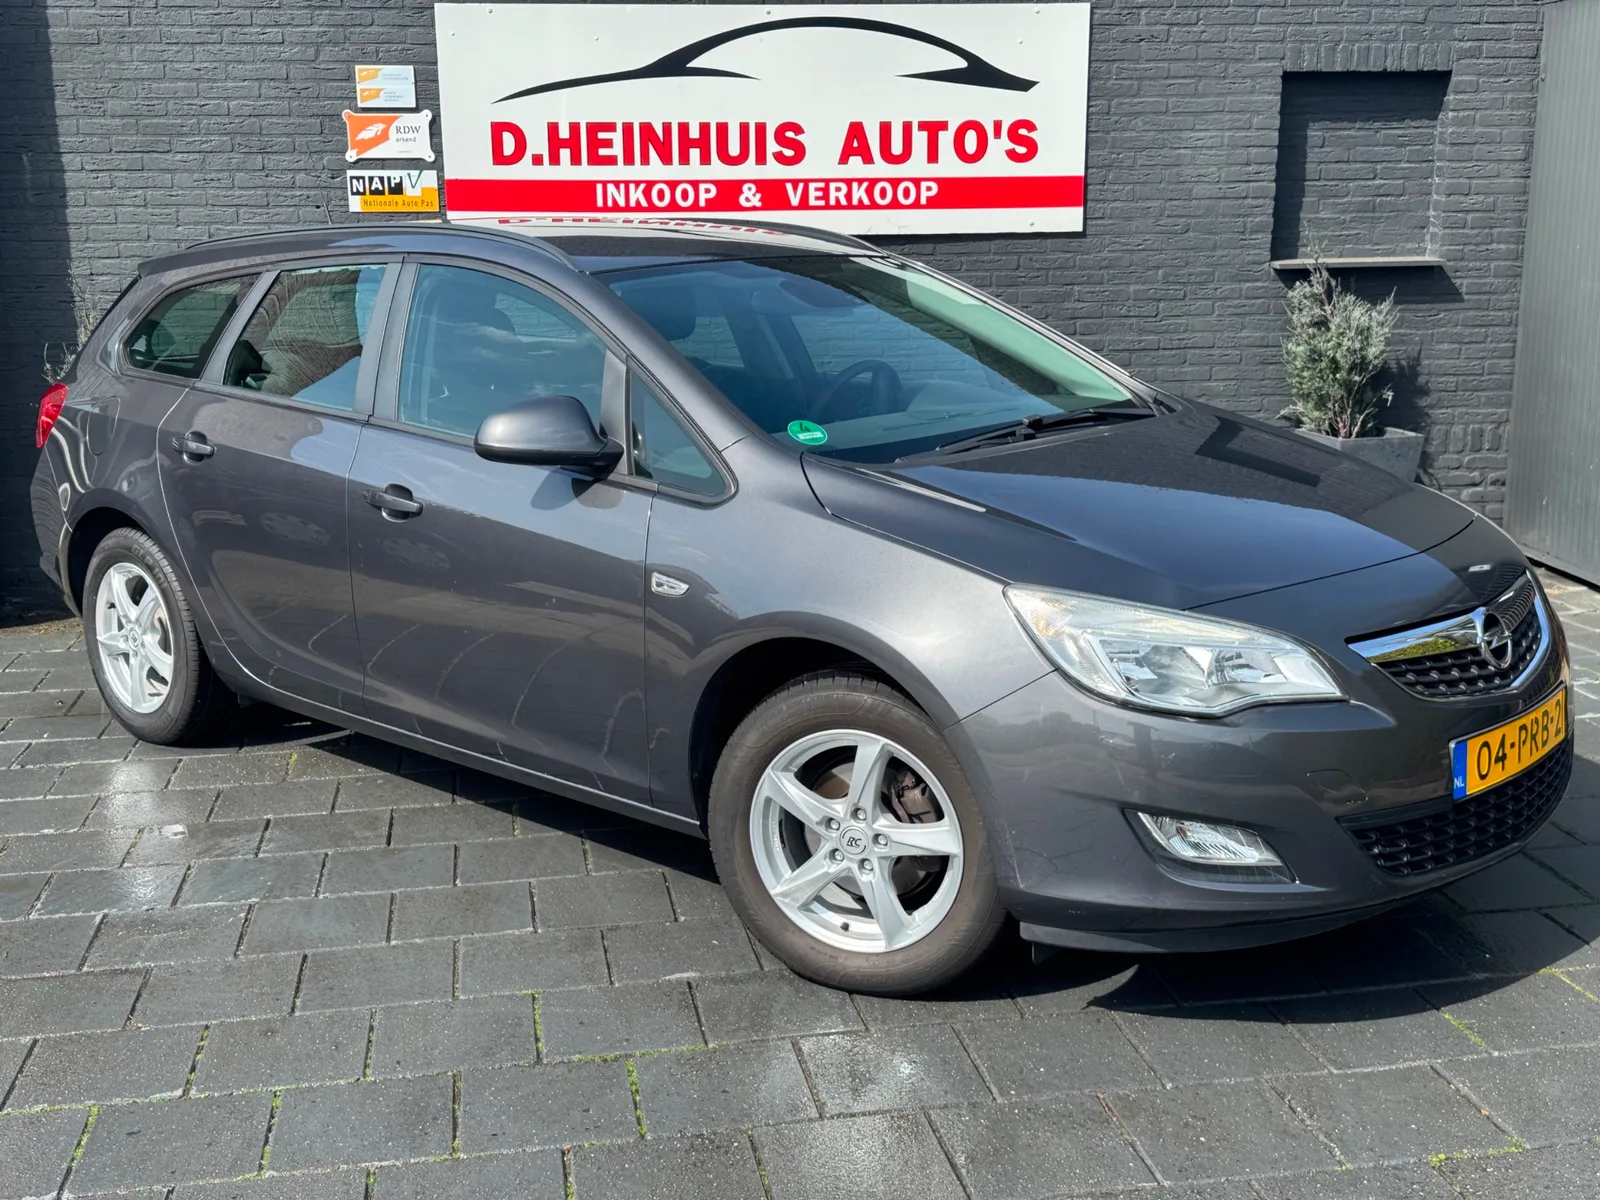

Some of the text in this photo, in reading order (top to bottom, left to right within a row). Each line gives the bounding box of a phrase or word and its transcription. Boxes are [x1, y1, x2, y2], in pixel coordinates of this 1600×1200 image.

[395, 125, 421, 134] RDW
[490, 119, 1039, 166] D.HEINHUIS AUTO'S
[363, 199, 434, 208] Nationale Auto Pas
[596, 181, 939, 208] INKOOP & VERKOOP
[1476, 698, 1562, 781] 04-PRB-2
[1453, 776, 1465, 789] NL
